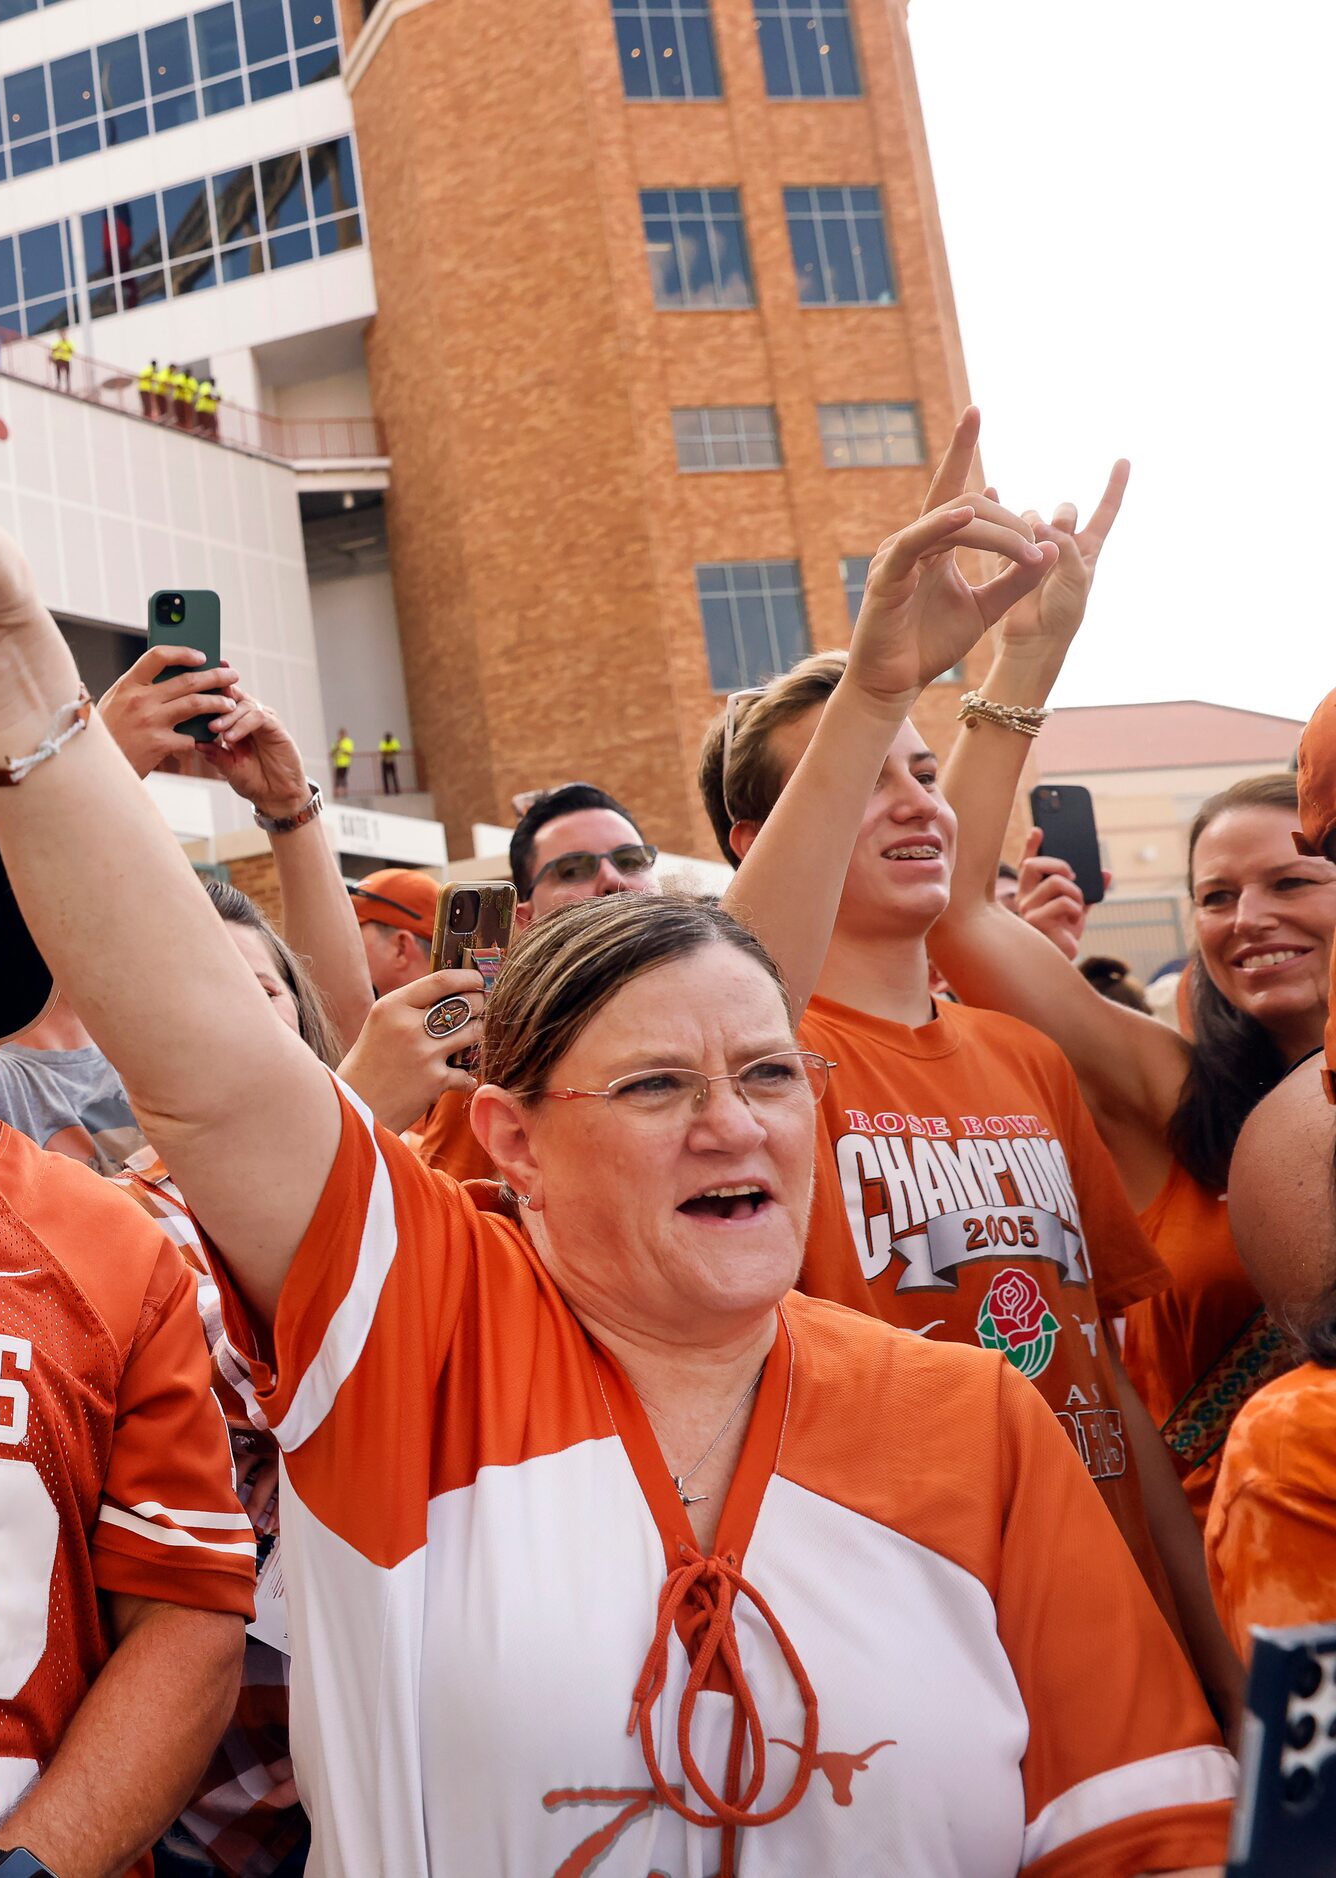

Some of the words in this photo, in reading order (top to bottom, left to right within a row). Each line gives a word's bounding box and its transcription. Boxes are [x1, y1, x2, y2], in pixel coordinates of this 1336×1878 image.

[844, 1109, 951, 1137] ROSE
[959, 1115, 1050, 1136] BOWL
[963, 1214, 1040, 1251] 2005
